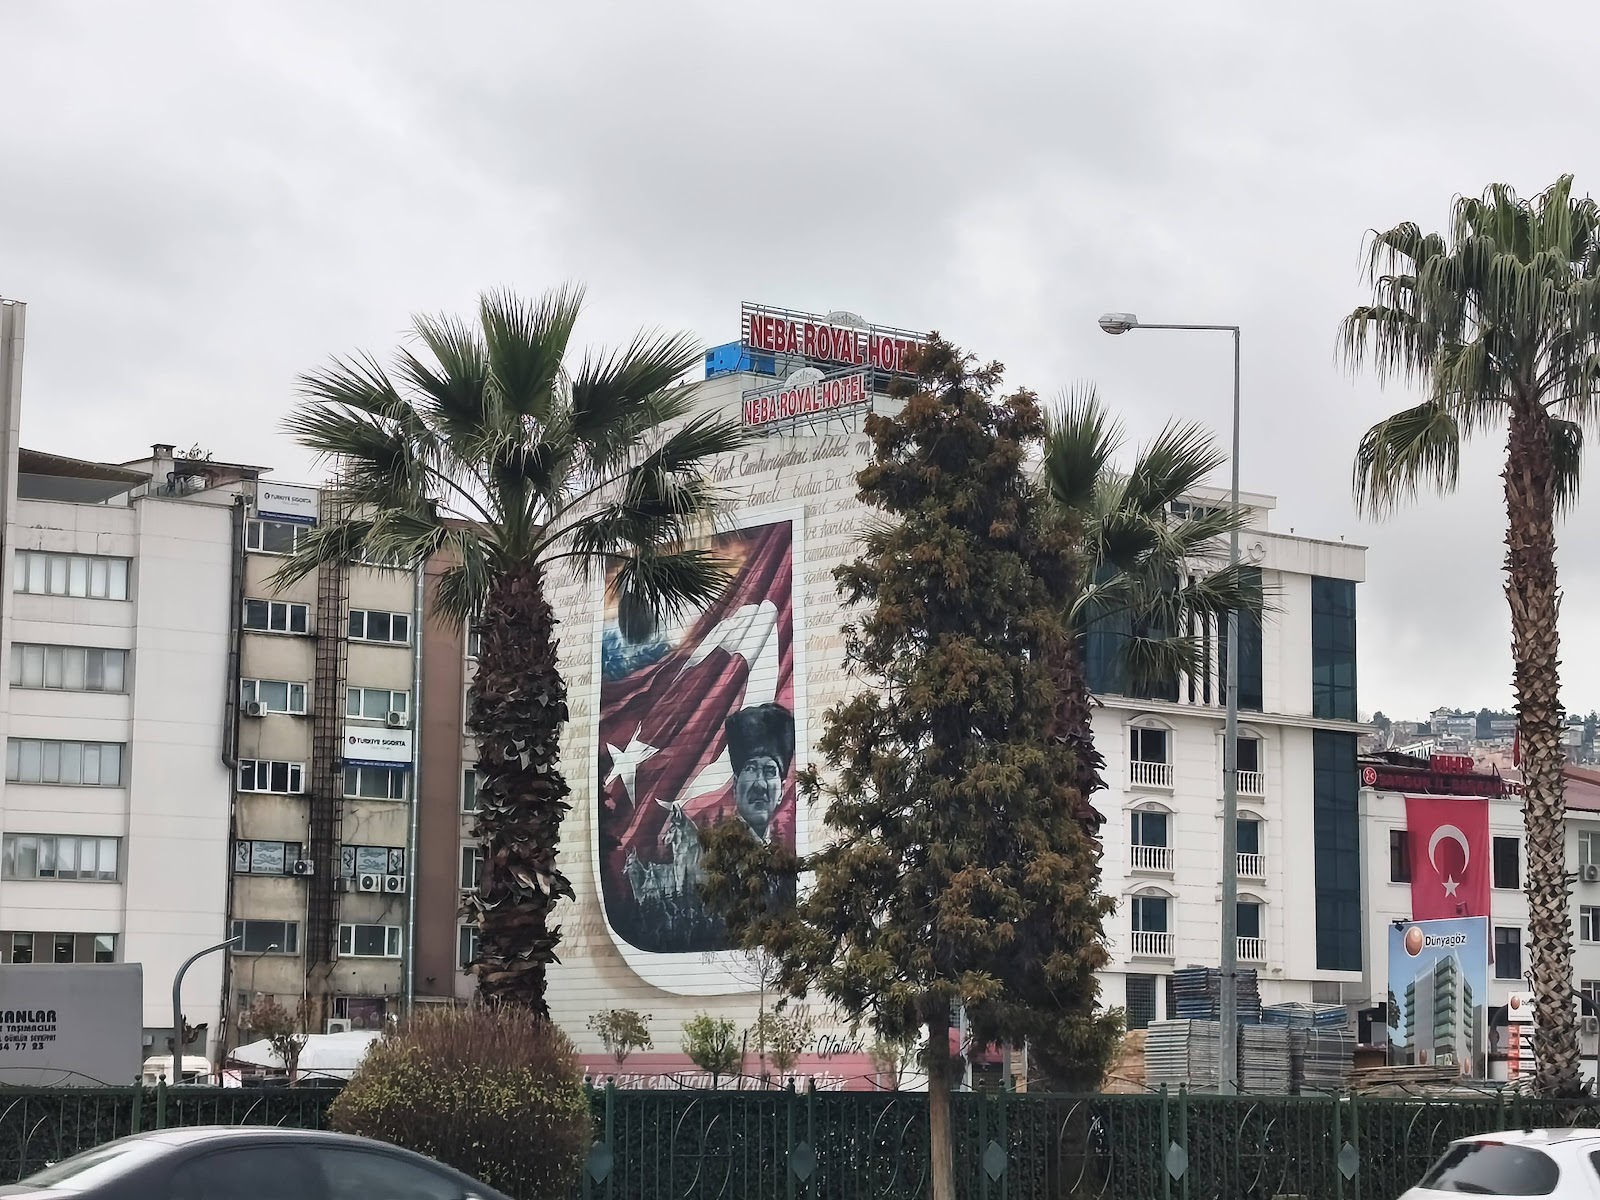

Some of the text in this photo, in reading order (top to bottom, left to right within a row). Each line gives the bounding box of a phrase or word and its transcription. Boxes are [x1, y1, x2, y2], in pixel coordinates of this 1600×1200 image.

[748, 313, 799, 356] NEBA
[803, 321, 864, 365] ROYAL
[743, 373, 868, 427] NEBA ROYAL HOTEL
[1425, 932, 1466, 947] Dünyagöz
[15, 1042, 27, 1051] 77
[32, 1042, 44, 1051] 23
